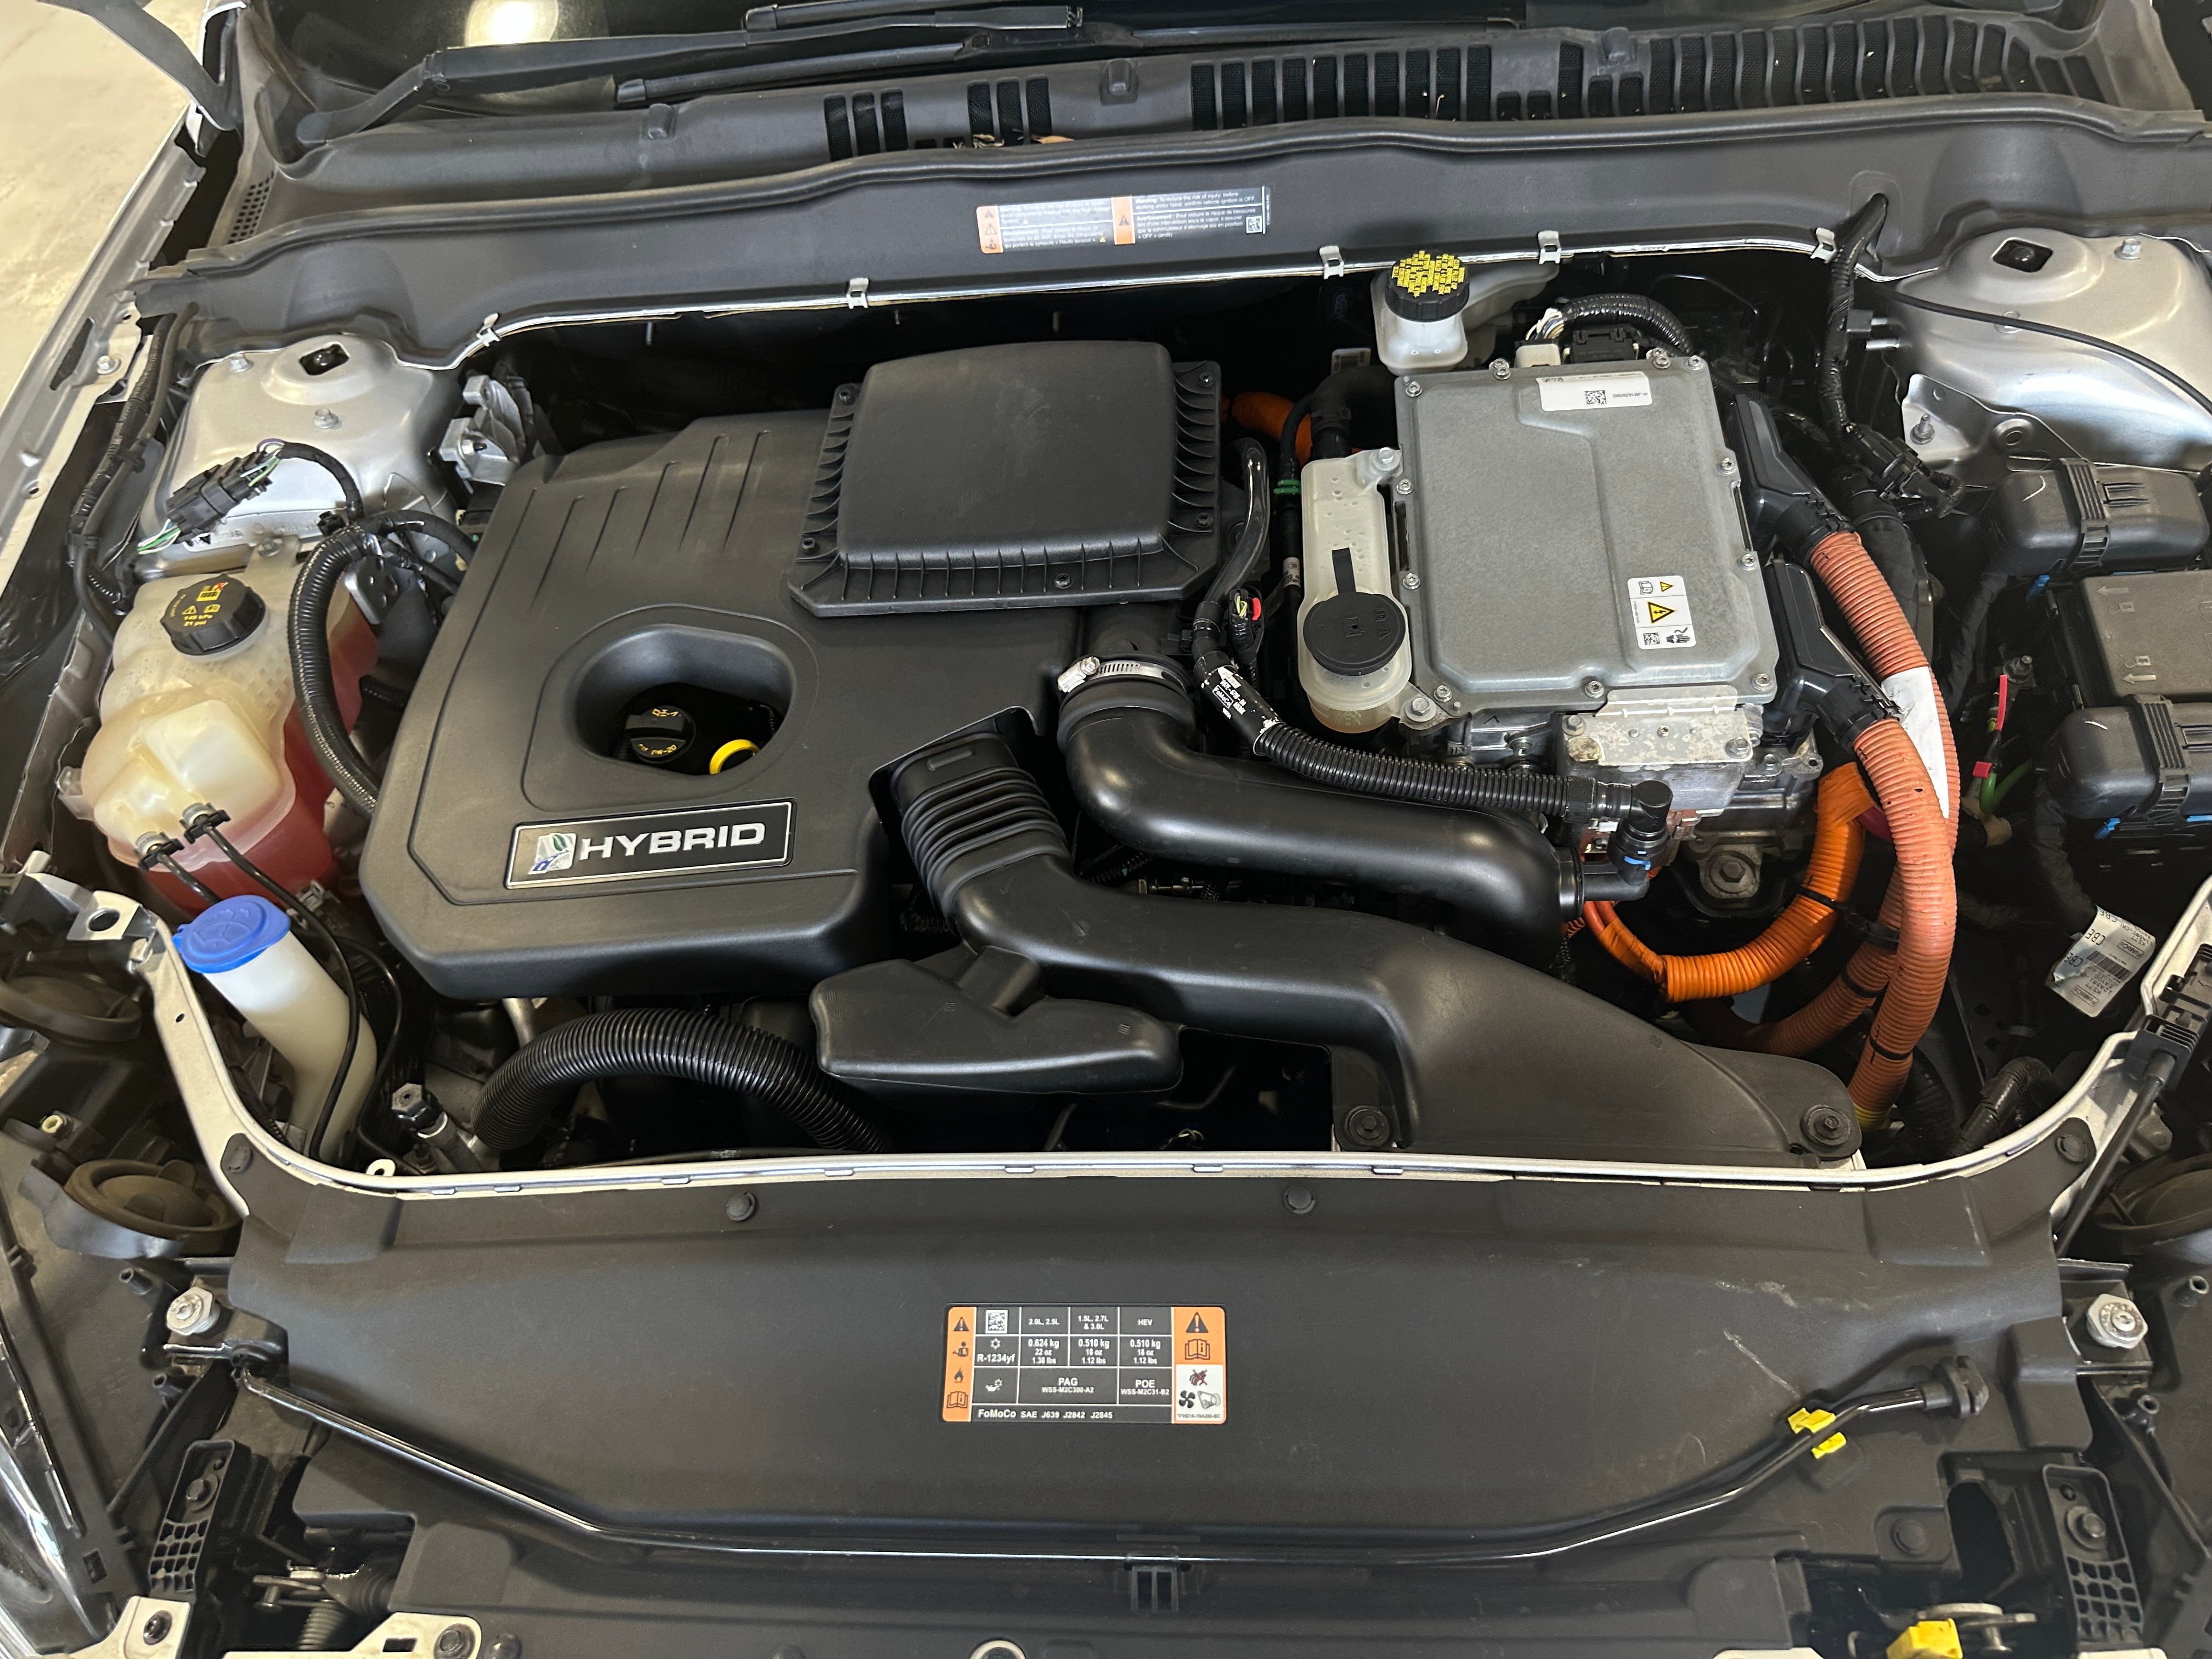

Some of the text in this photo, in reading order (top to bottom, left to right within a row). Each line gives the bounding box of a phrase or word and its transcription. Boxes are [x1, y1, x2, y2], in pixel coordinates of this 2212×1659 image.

[579, 822, 766, 861] HYBRID
[2085, 928, 2106, 946] CBE
[1028, 1338, 1060, 1350] 0.624 kg
[1078, 1338, 1110, 1350] 0.510 kg
[1130, 1339, 1161, 1350] 0.510 kg
[1035, 1348, 1043, 1356] 22
[977, 1353, 1016, 1364] R-1234yf
[1058, 1377, 1078, 1386] PAG
[1135, 1379, 1155, 1388] POE
[978, 1409, 1017, 1418] FoMoCo
[1091, 1411, 1113, 1419] J2845
